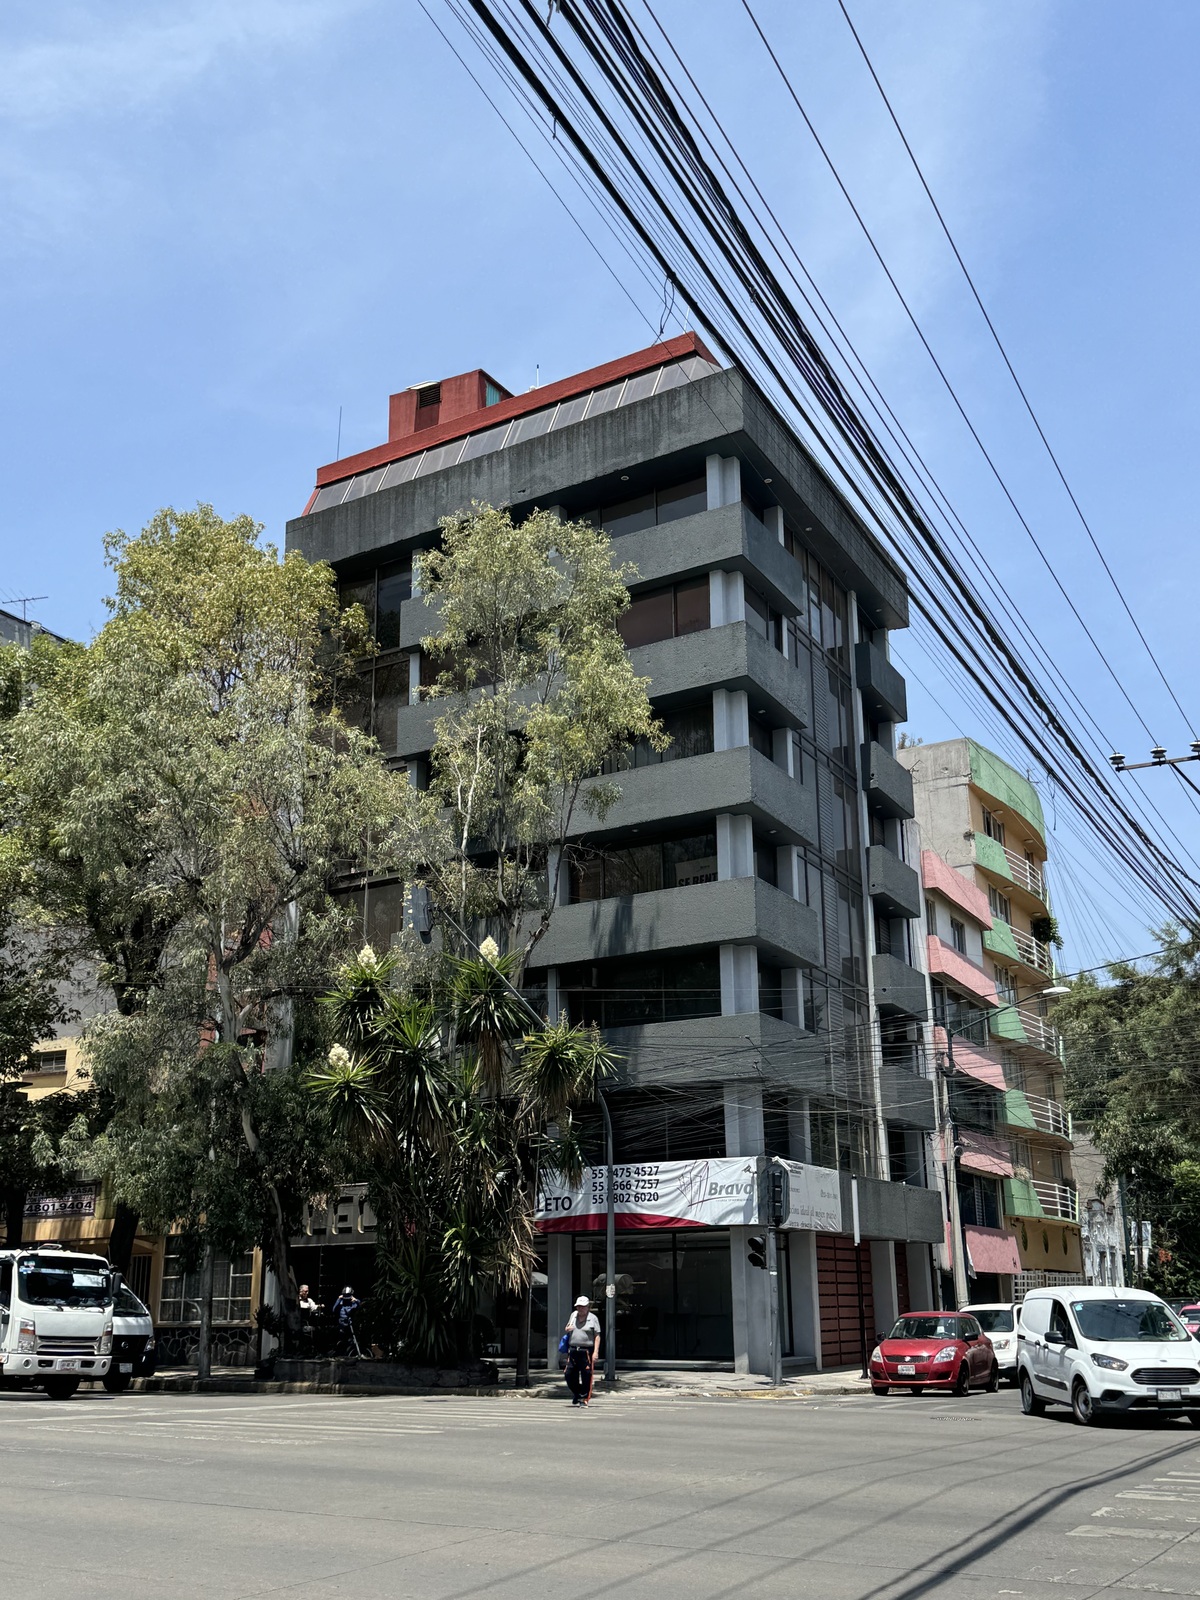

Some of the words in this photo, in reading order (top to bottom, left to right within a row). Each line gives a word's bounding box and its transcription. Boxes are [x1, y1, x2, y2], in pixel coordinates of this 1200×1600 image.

[592, 1168, 604, 1179] 55
[606, 1167, 631, 1178] 475
[634, 1166, 660, 1177] 4527
[70, 1187, 93, 1195] CASA
[592, 1181, 604, 1192] 55
[606, 1180, 631, 1191] 666
[634, 1179, 660, 1190] 7257
[708, 1181, 754, 1196] Bravo
[592, 1194, 604, 1205] 55
[606, 1193, 631, 1204] 802
[634, 1192, 659, 1203] 6020
[26, 1201, 92, 1212] 4801.9404
